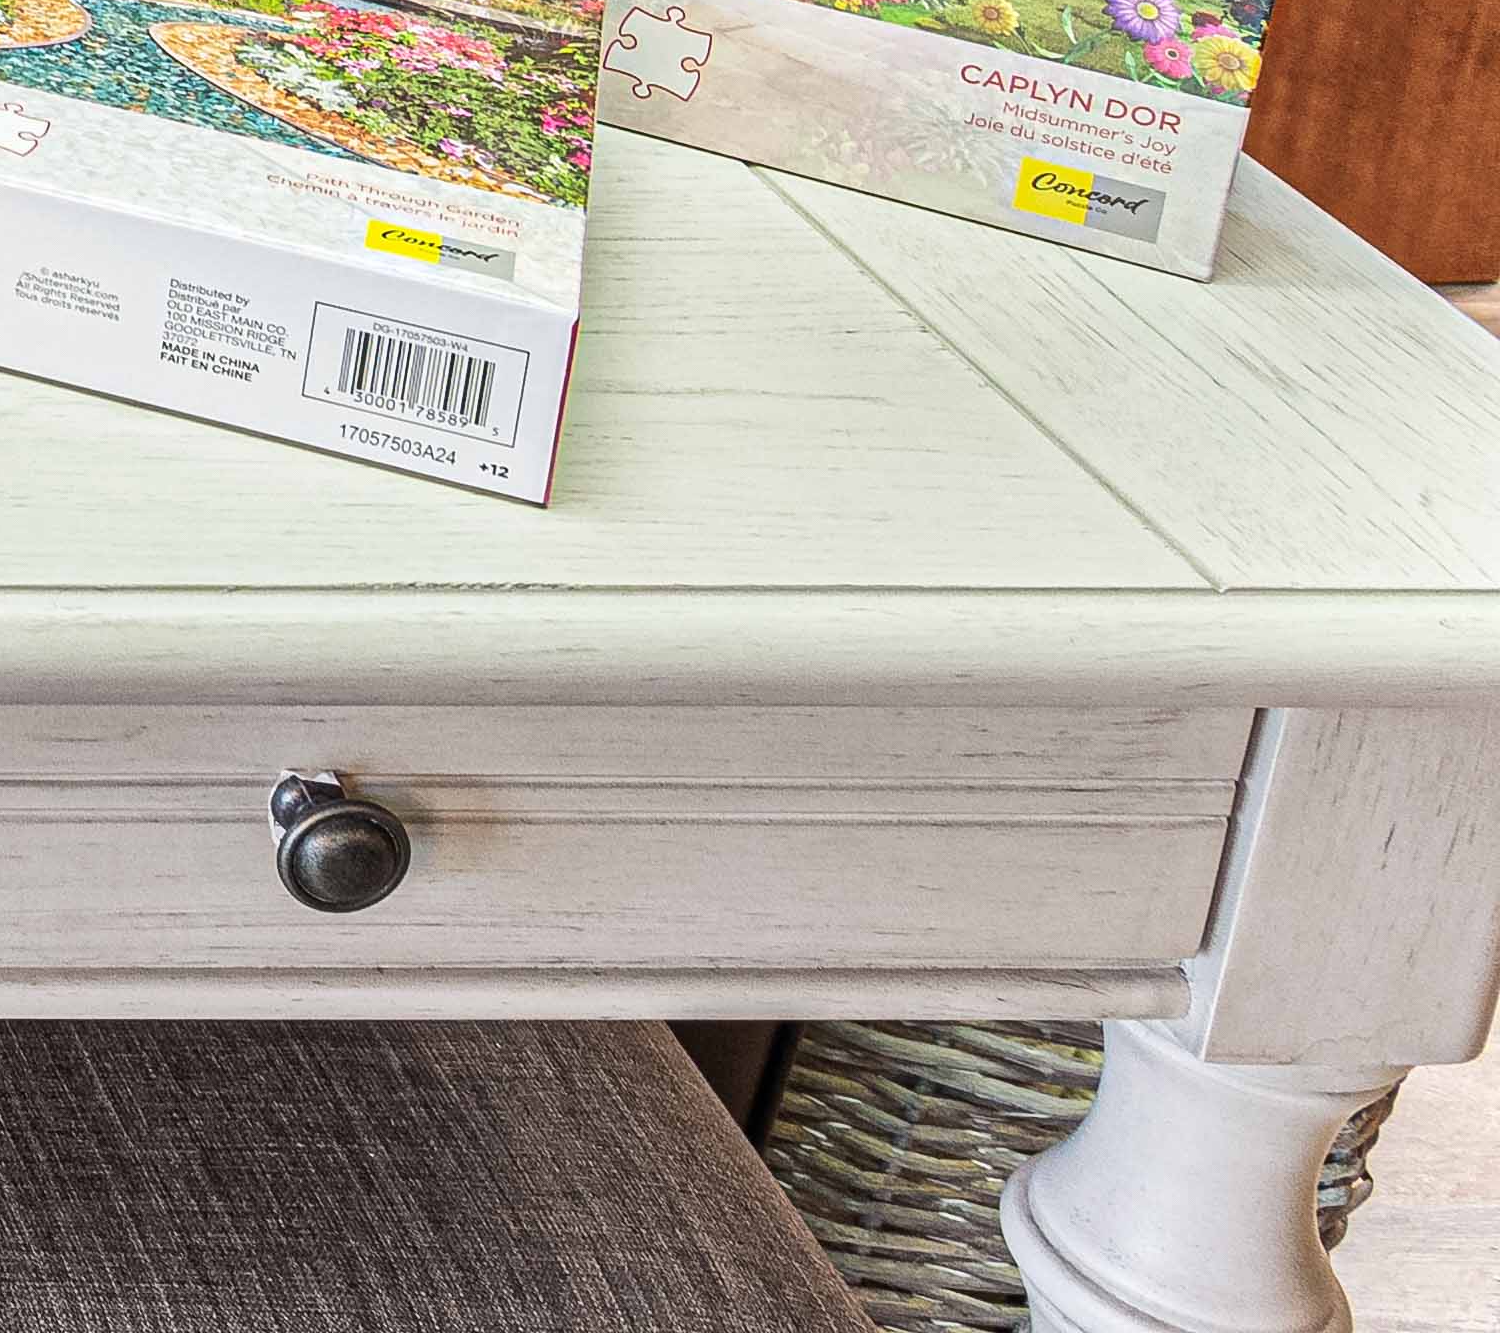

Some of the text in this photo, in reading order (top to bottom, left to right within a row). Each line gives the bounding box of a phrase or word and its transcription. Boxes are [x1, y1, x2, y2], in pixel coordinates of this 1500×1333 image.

[960, 65, 1181, 134] CAPLYN DOR
[964, 113, 1172, 174] Joie du solstice d'été
[1003, 102, 1176, 156] Midsummer's Joy
[306, 172, 523, 229] Path Through Garden
[1031, 172, 1148, 215] Concord
[381, 229, 499, 263] Concord
[166, 300, 290, 337] OLD EAST MAIN CO.
[166, 310, 286, 347] 100 MISSION RIDGE
[160, 351, 252, 382] FAIT EN CHINE
[161, 340, 260, 373] MADE IN CHINA
[339, 424, 457, 465] 17057503A24
[479, 463, 509, 478] +12
